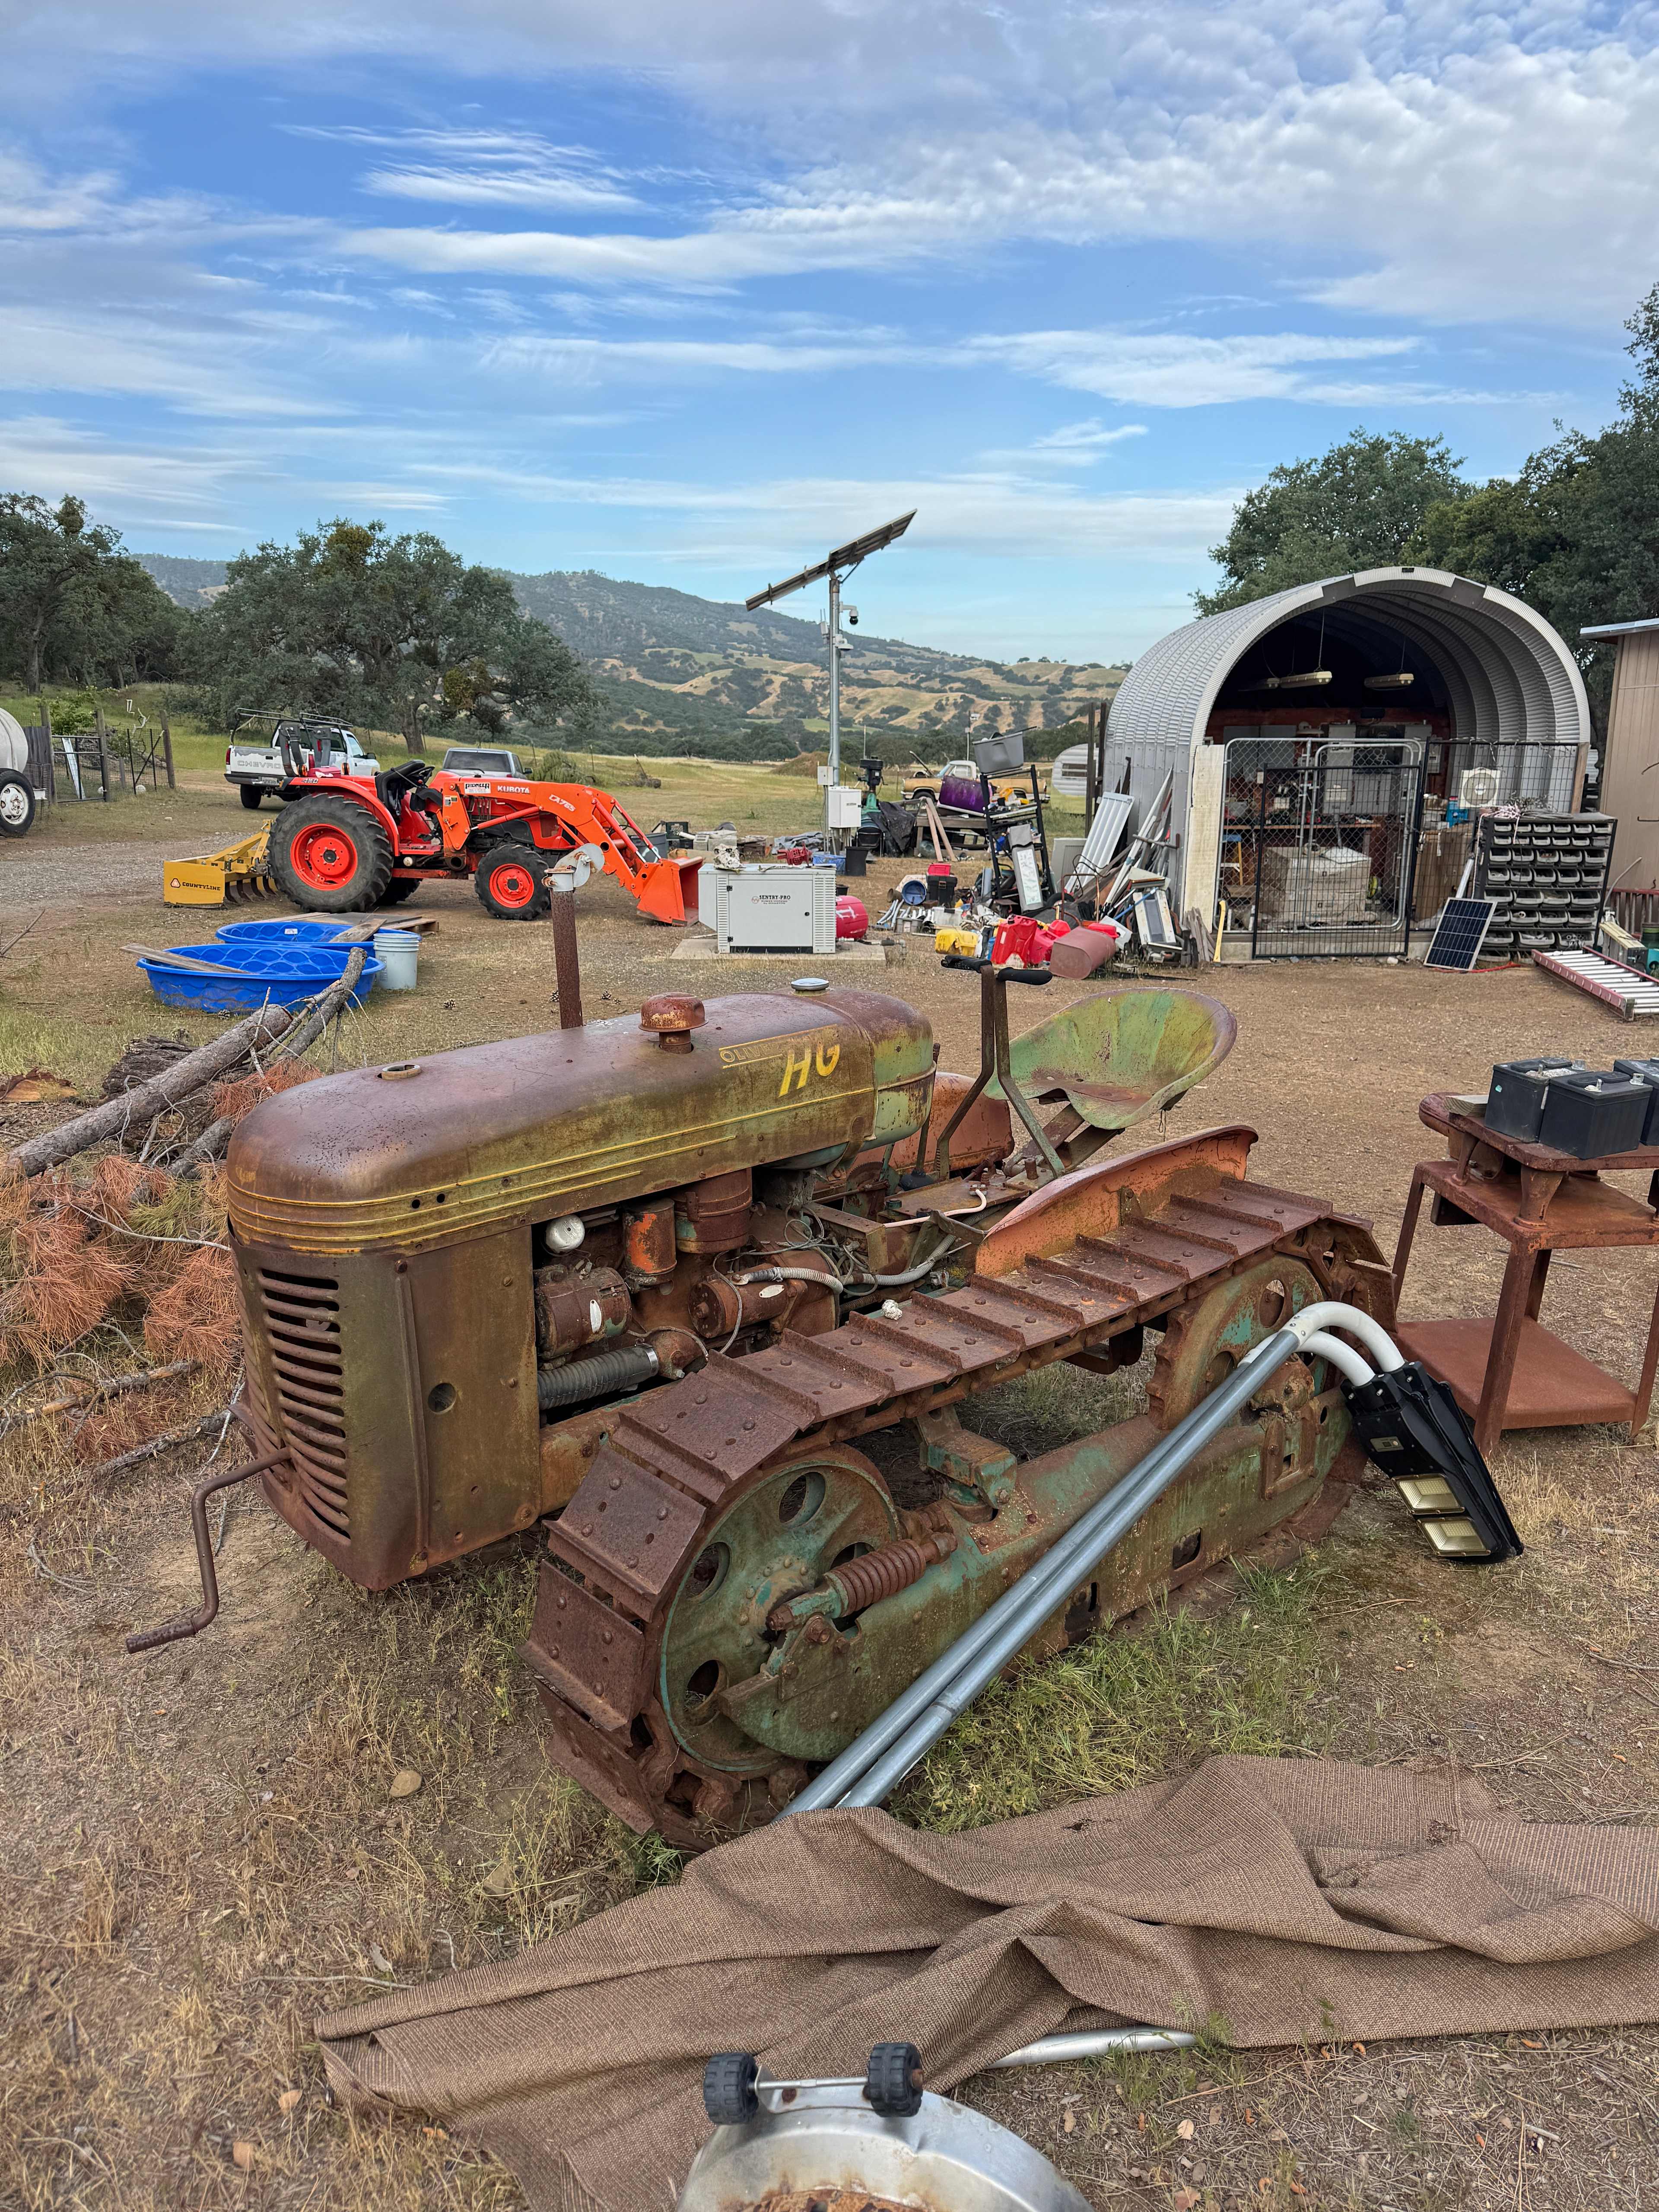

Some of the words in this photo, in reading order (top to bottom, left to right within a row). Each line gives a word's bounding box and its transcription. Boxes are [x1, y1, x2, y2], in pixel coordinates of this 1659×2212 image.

[237, 760, 283, 769] CHEVRO
[497, 785, 530, 794] KUBOTA
[182, 882, 220, 890] COUNTYLINE
[778, 1038, 840, 1097] HG
